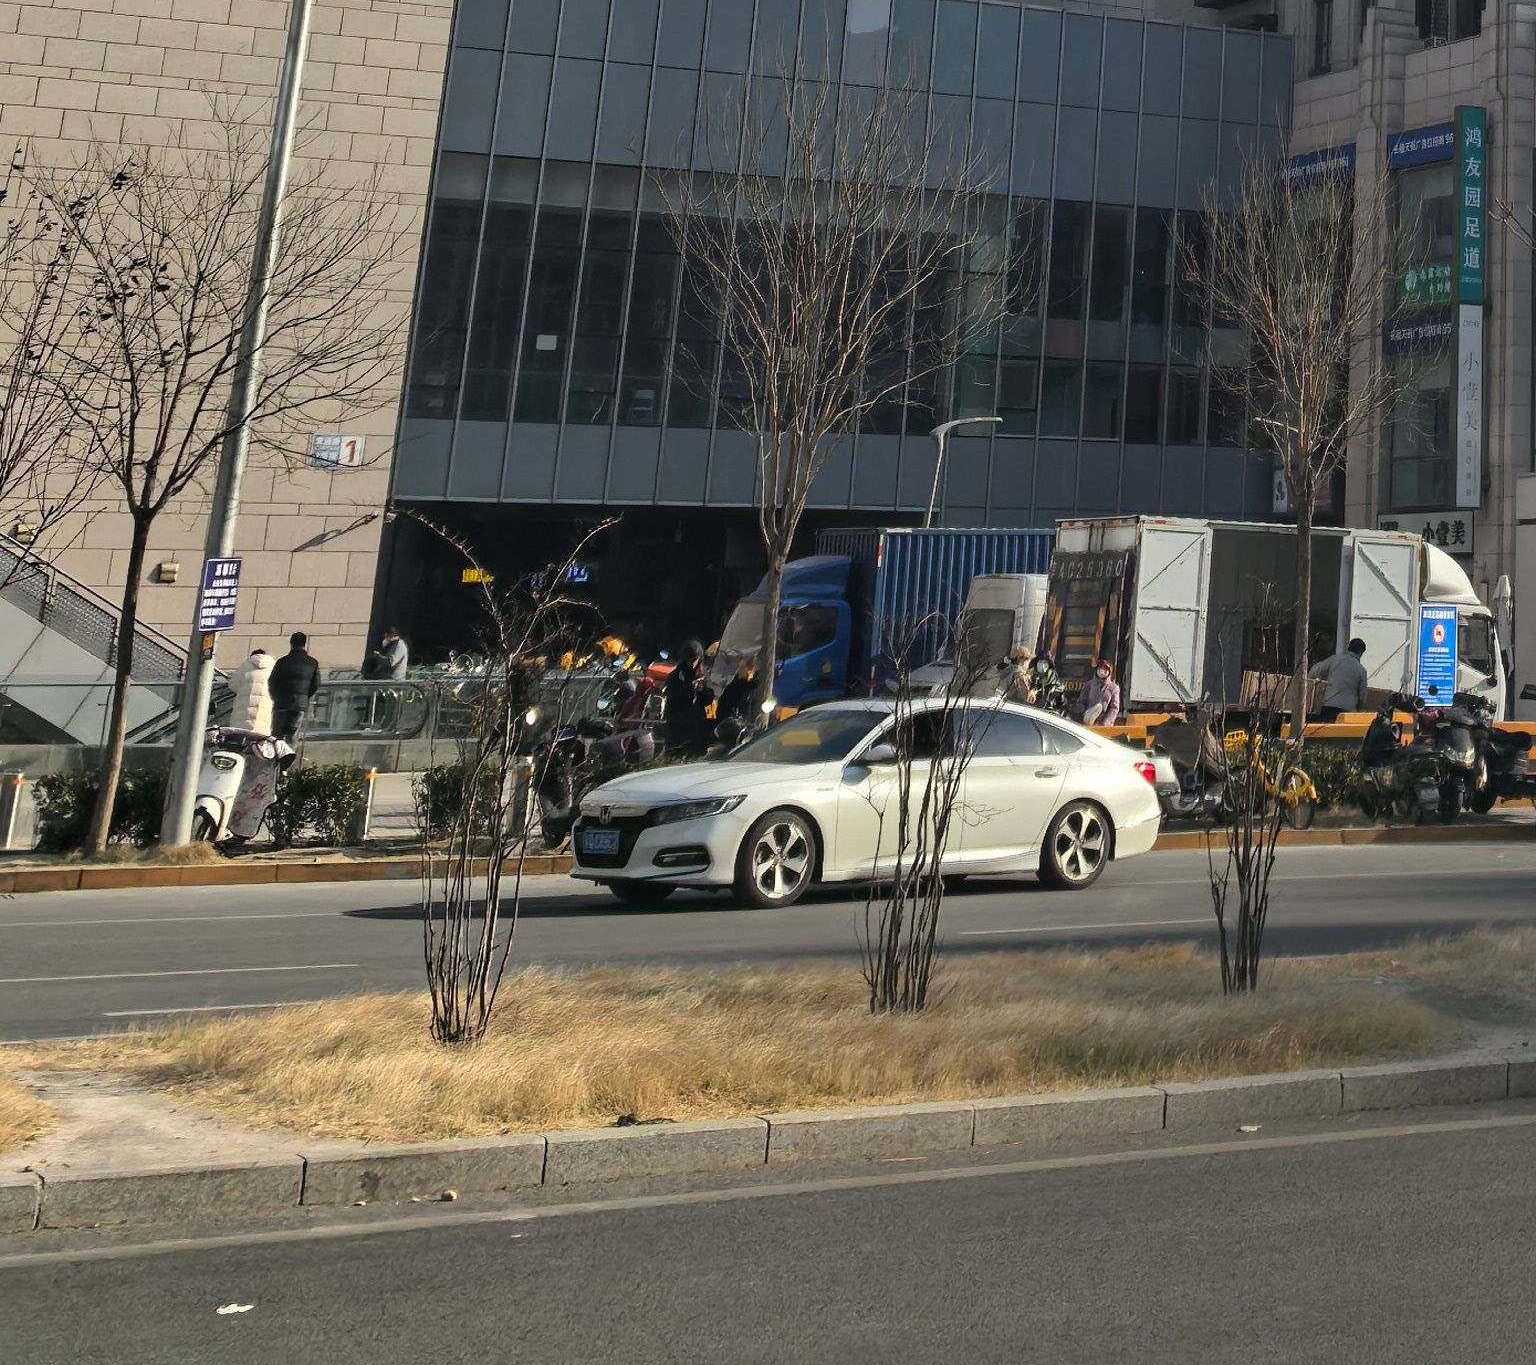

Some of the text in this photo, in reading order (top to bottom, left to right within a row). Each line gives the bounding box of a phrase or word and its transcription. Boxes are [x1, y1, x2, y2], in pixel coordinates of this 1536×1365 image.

[1463, 126, 1482, 268] 鸿友园足道
